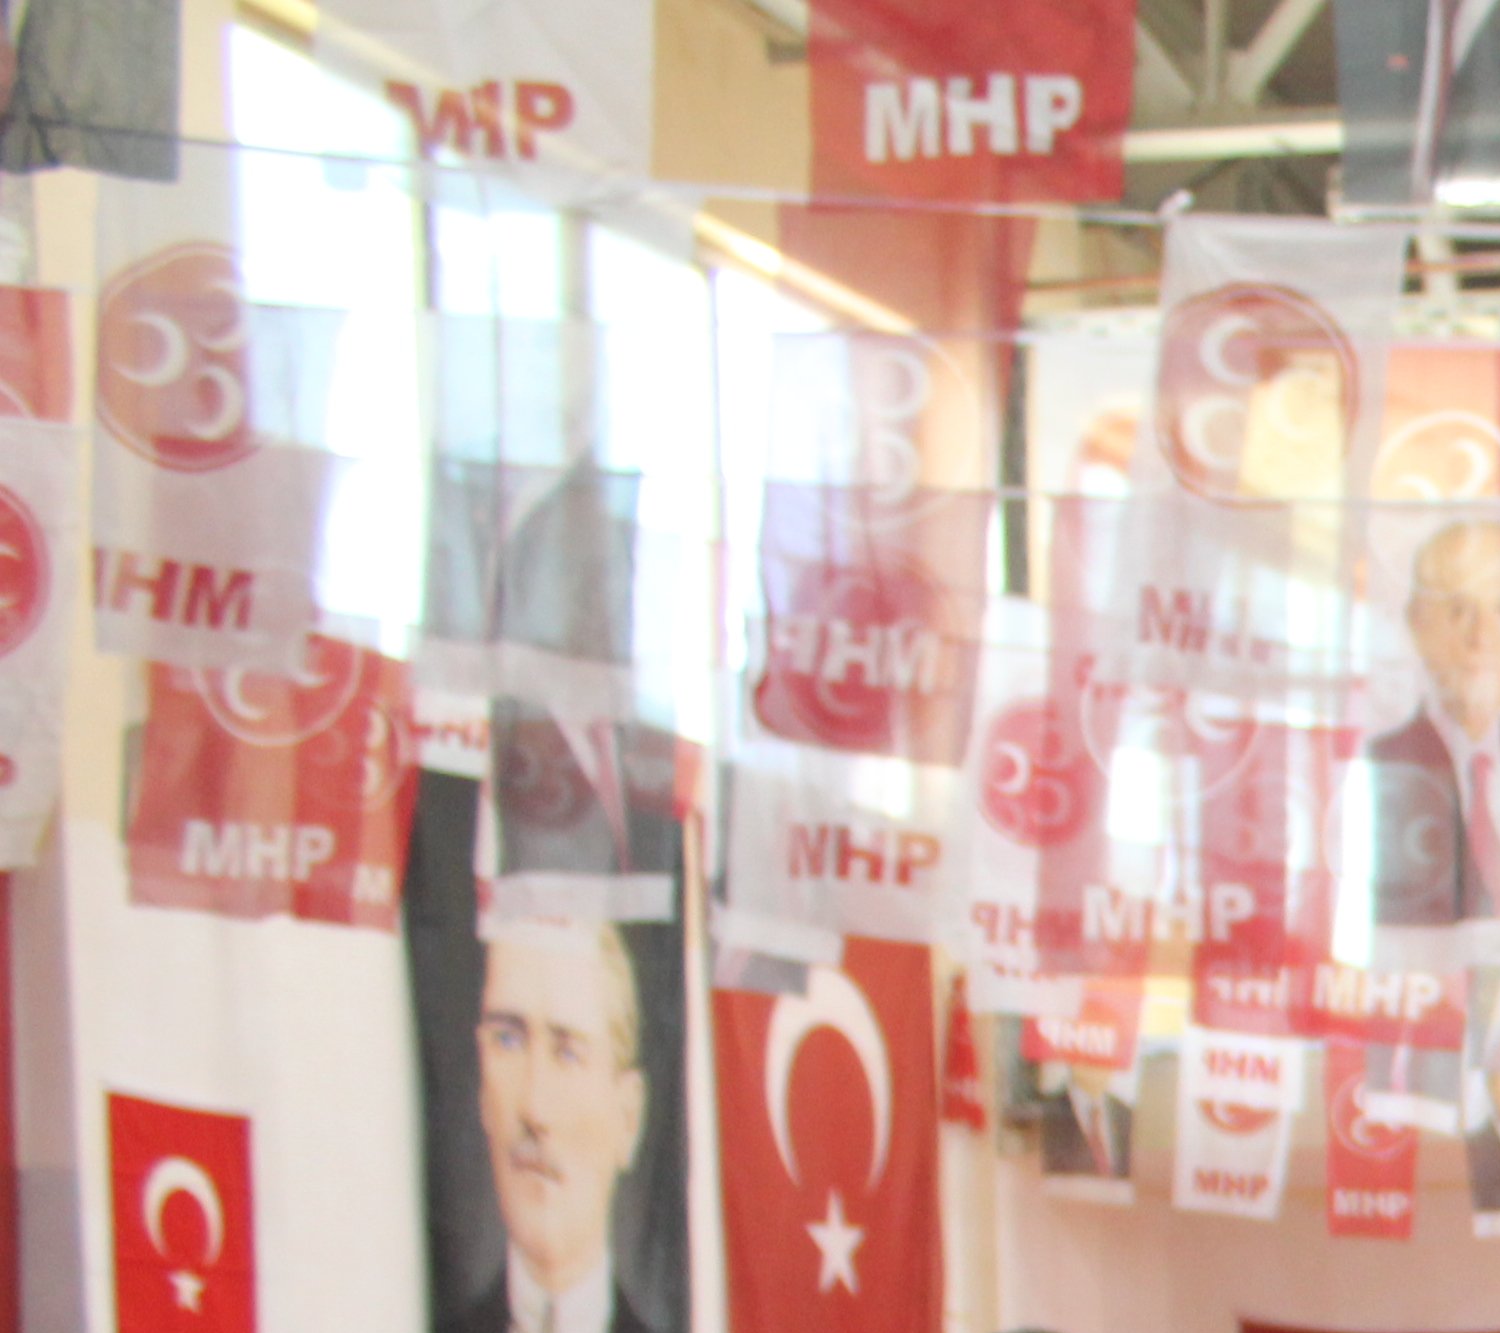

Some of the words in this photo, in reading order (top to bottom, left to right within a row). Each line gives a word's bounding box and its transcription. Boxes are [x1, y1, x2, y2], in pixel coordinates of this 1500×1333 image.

[385, 80, 574, 159] MHP
[864, 74, 1083, 163] MHP
[180, 819, 336, 881] MHP
[1083, 884, 1254, 943] MHP
[1314, 964, 1443, 1020] MHP
[1334, 1189, 1409, 1219] MHP
